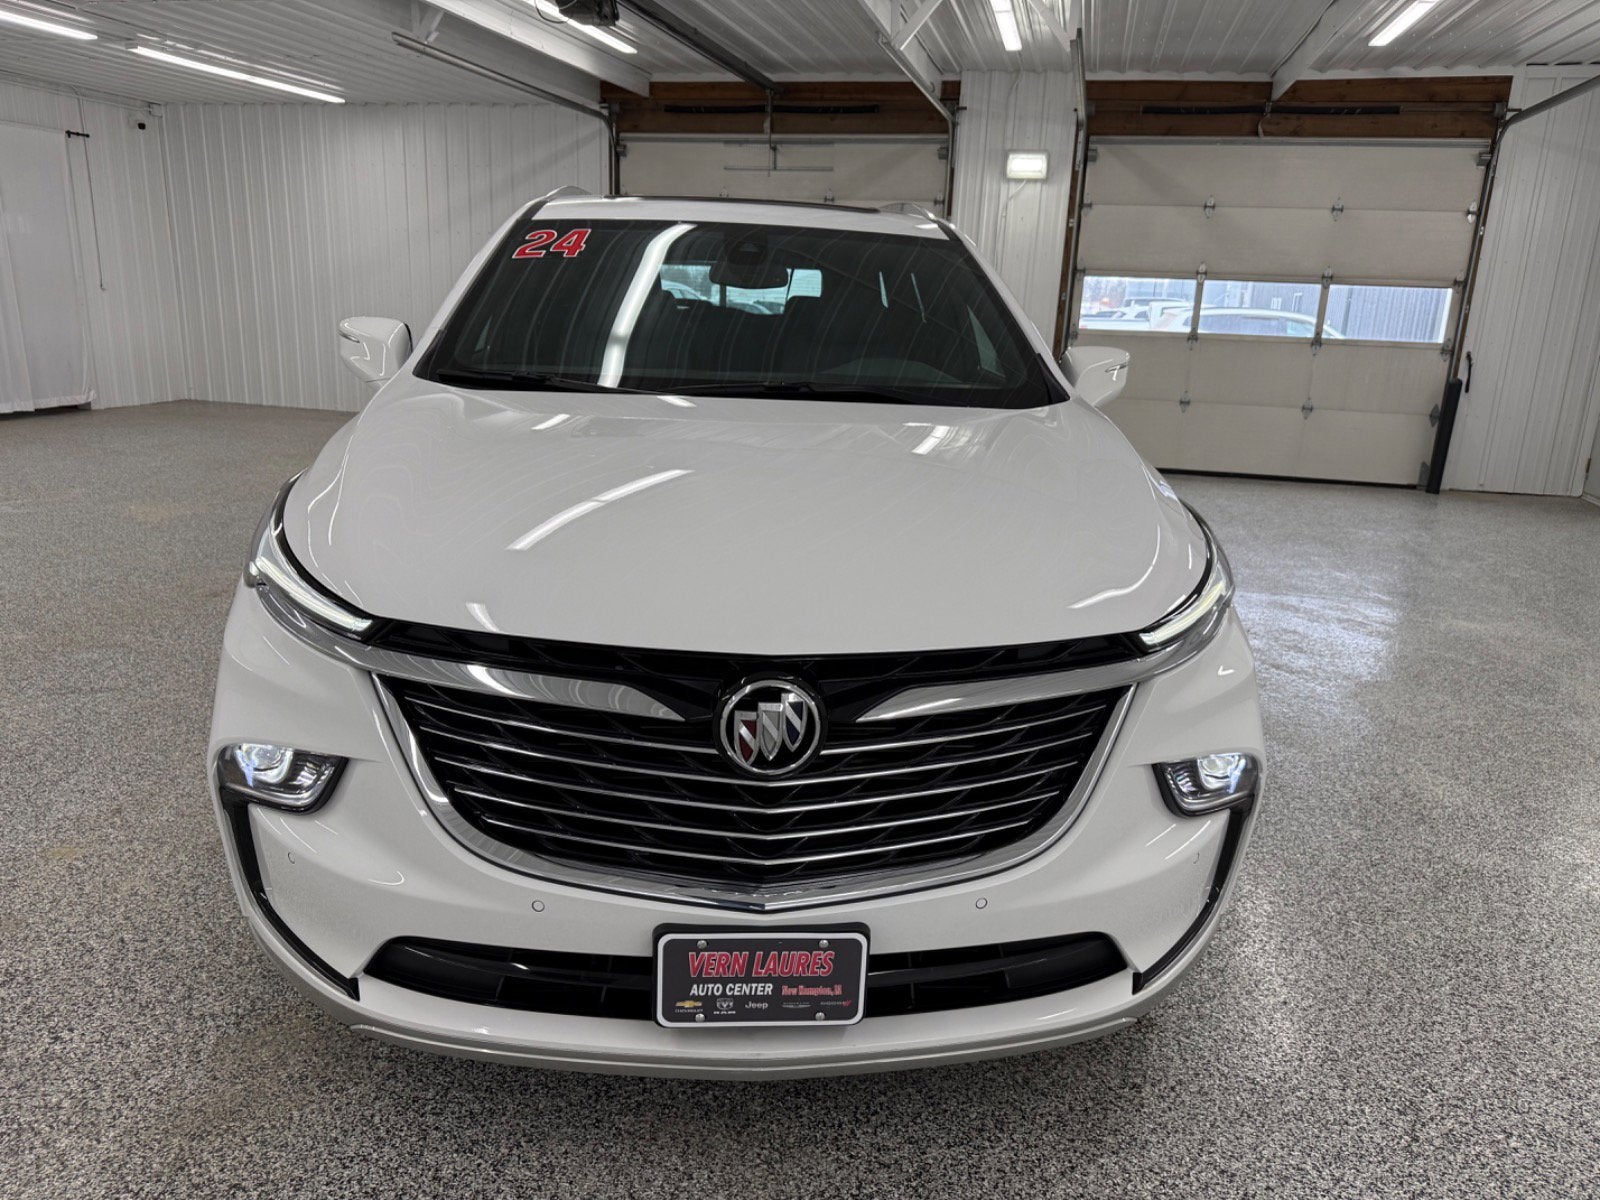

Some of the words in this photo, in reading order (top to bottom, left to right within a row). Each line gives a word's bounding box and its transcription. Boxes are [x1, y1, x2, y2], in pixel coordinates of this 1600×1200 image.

[512, 229, 592, 258] 24
[688, 951, 749, 977] VERN
[752, 950, 835, 977] LAURES
[689, 984, 722, 996] AUTO
[725, 983, 773, 995] CENTER
[745, 1001, 768, 1009] Jeep
